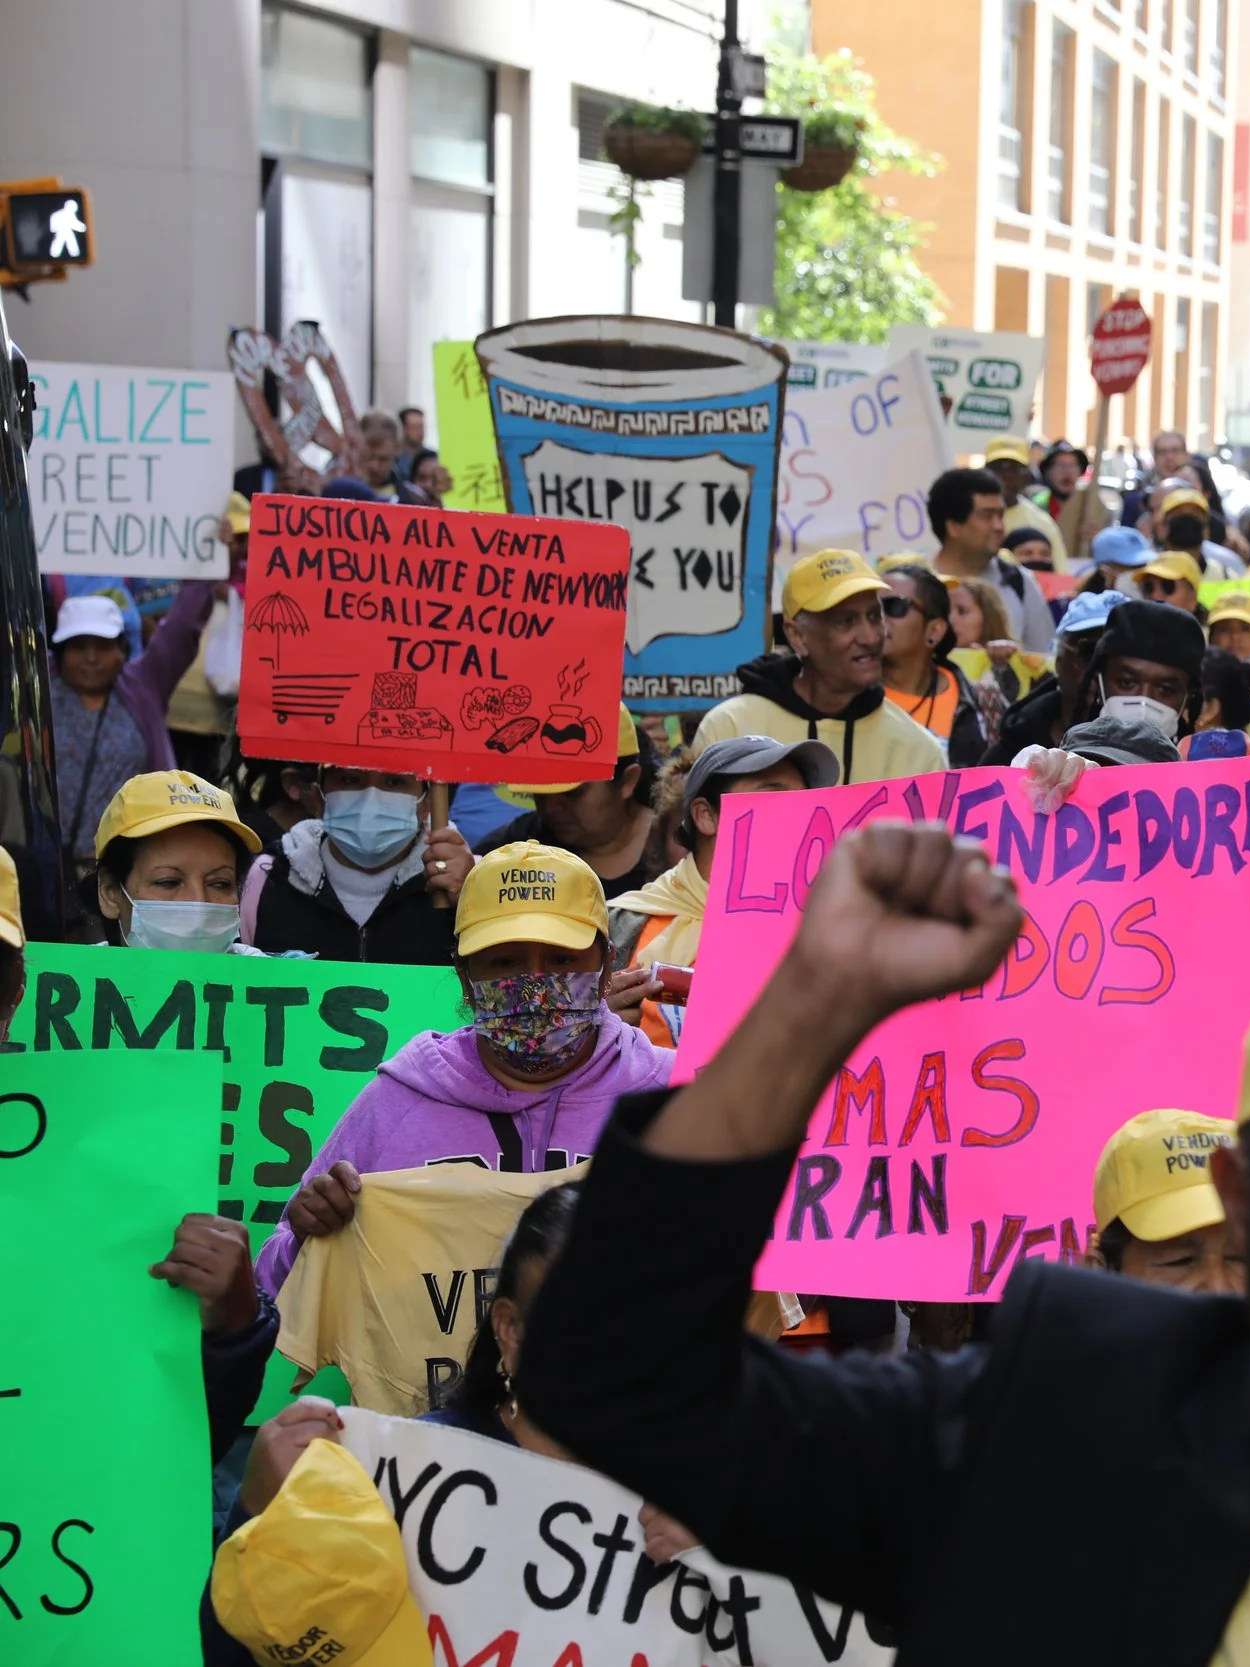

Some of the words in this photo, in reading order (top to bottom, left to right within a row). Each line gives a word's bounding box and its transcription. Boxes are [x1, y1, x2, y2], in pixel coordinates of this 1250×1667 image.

[970, 361, 1019, 388] FOR
[850, 374, 899, 437] OF
[30, 453, 162, 503] REET
[258, 503, 391, 545] JUSTICIA
[471, 526, 565, 564] VENTA
[858, 491, 928, 552] FO
[266, 546, 468, 593] AMBULANTE
[476, 563, 515, 599] DE
[324, 588, 555, 640] LEGALIZACION
[387, 636, 508, 681] TOTAL
[498, 886, 555, 903] POWER!
[500, 868, 556, 885] VENDOR
[14, 971, 390, 1072] RMITS
[808, 1038, 1040, 1149] MAS
[772, 1154, 949, 1242] RAN
[374, 1456, 498, 1585] YC
